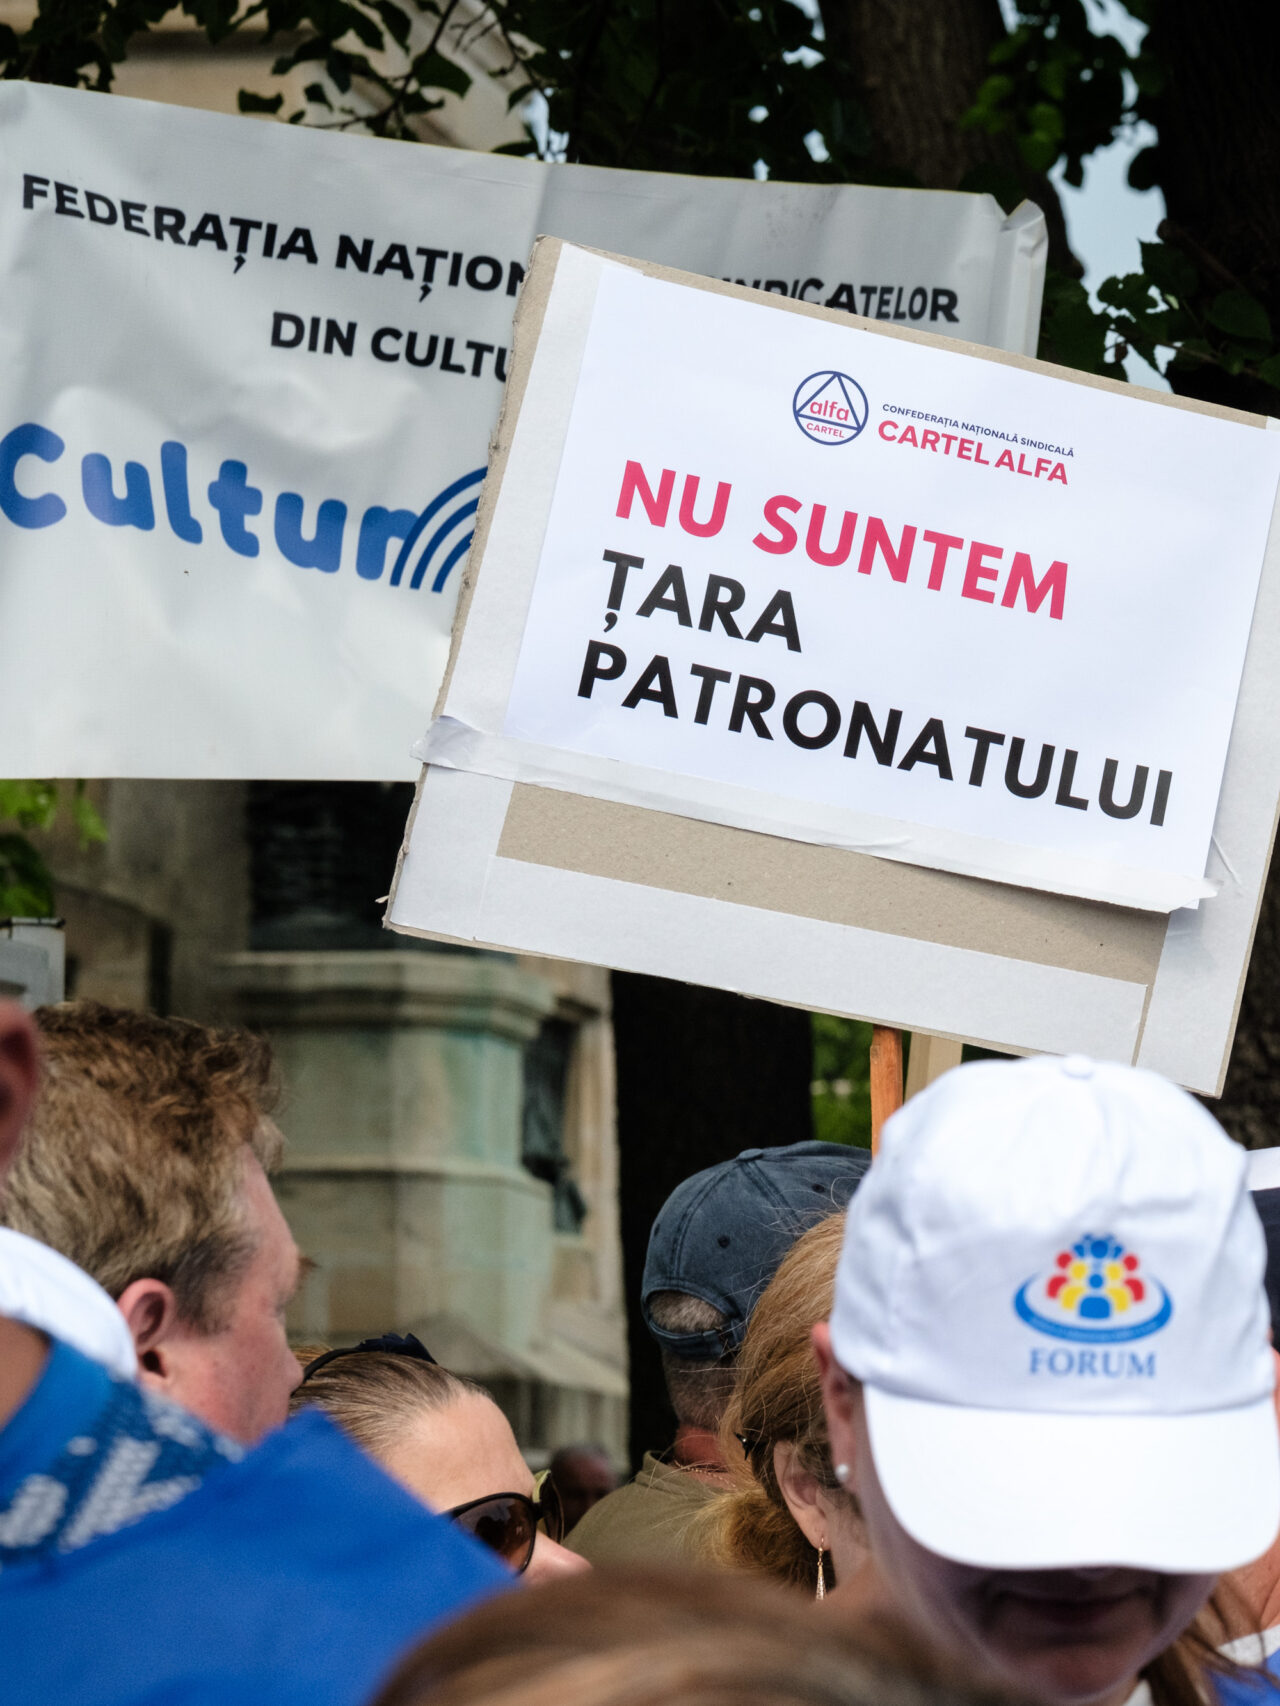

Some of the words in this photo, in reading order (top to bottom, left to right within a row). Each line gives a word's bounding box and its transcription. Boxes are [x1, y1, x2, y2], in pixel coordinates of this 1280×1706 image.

[22, 174, 318, 274] FEDERAȚIA
[271, 312, 357, 357] DIN
[806, 422, 845, 439] CARTEL
[809, 399, 850, 421] alfa
[882, 403, 960, 429] CONFEDERAȚIA
[961, 421, 1019, 444] NAȚIONALĂ
[1020, 437, 1075, 458] SINDICALĂ
[878, 420, 990, 466] CARTEL
[995, 449, 1069, 486] ALFA
[615, 460, 732, 538] NU
[752, 494, 1069, 620] SUNTEM
[602, 549, 802, 653] ȚARA
[577, 640, 1173, 827] PATRONATULUI
[1029, 1348, 1157, 1378] FORUM
